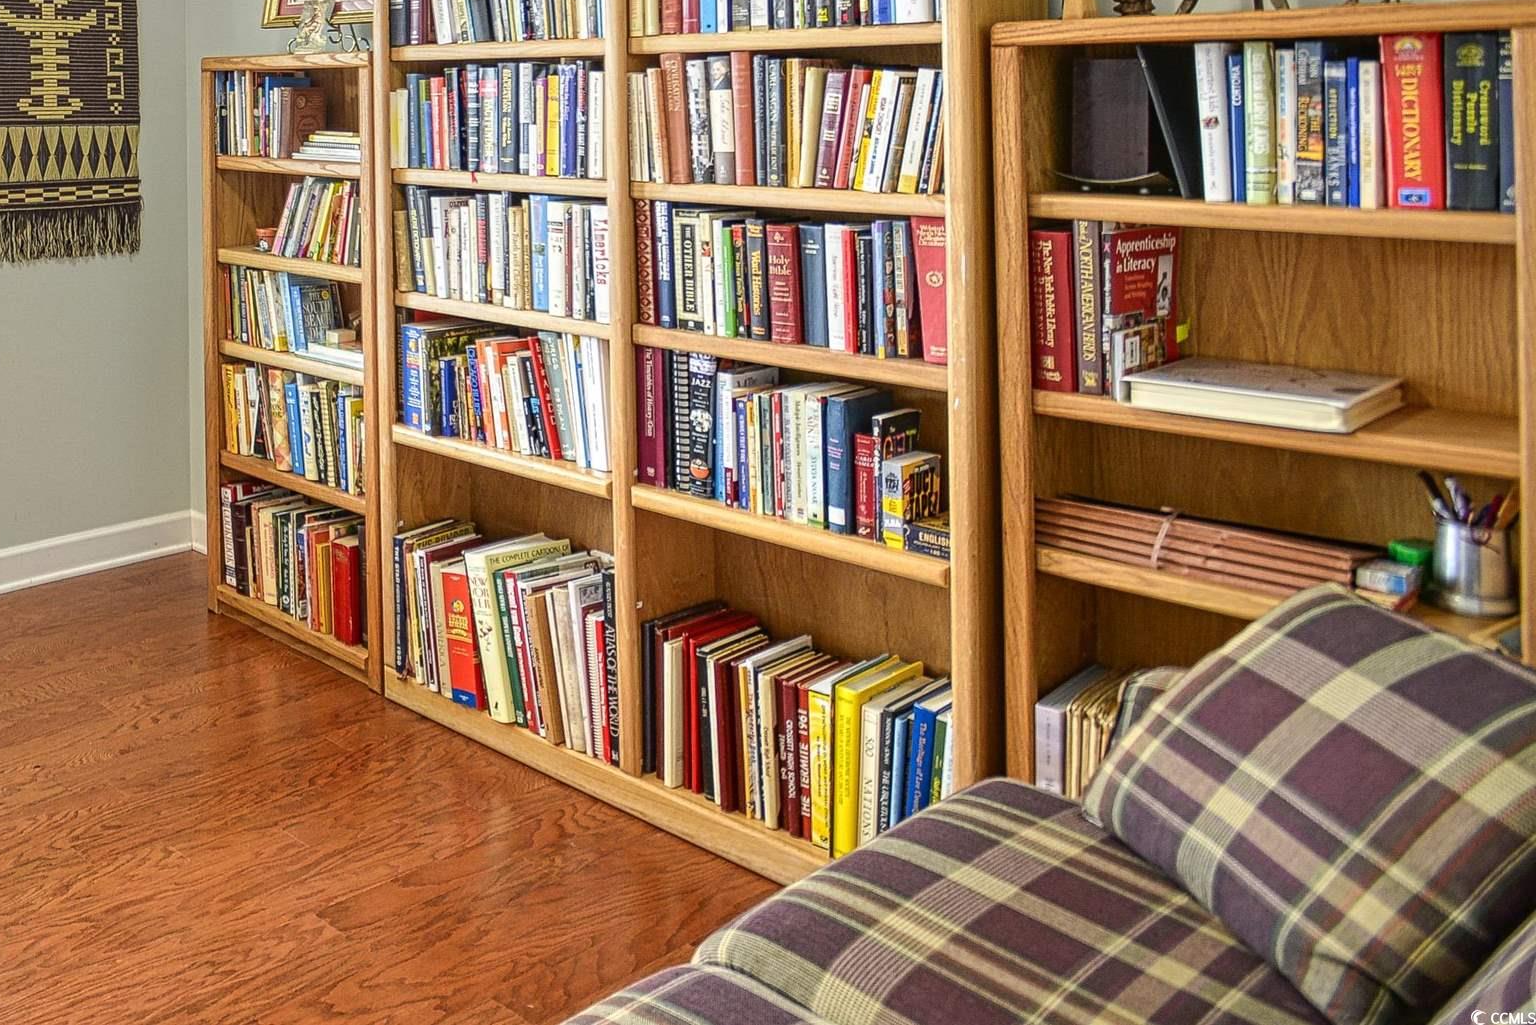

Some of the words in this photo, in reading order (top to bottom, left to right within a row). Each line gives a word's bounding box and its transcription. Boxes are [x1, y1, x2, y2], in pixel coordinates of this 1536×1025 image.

[669, 60, 681, 112] CIVILISATION
[769, 91, 778, 122] SAGAN
[1208, 95, 1219, 113] kids
[1328, 87, 1338, 139] AFFLICTION
[1450, 79, 1464, 146] Dictionary
[1466, 92, 1478, 134] Puzzle
[1479, 79, 1492, 146] Crossword
[1297, 96, 1310, 152] RECKONING
[1309, 115, 1321, 133] THE
[1401, 77, 1422, 182] DICTIONARY
[1327, 146, 1340, 187] BANKS
[593, 218, 608, 286] Limericks
[683, 239, 695, 277] OTHER
[1041, 239, 1053, 256] The
[1116, 232, 1176, 258] Apprenticeship
[751, 250, 761, 274] Word
[768, 255, 791, 265] Holy
[1043, 256, 1053, 275] New
[1079, 240, 1094, 280] NORTH
[1116, 261, 1123, 273] in
[1123, 256, 1156, 273] Literacy
[684, 279, 695, 312] BIBLE
[735, 277, 743, 296] Family
[752, 275, 763, 315] Histories
[1044, 275, 1054, 294] York
[303, 302, 331, 313] SOUTH
[1045, 294, 1055, 319] Public
[1081, 279, 1095, 332] AMERICAN
[303, 314, 332, 327] BEACH
[1045, 318, 1056, 348] Library
[547, 337, 559, 370] LYRICS
[645, 348, 654, 360] The
[1082, 333, 1097, 362] BIRDS
[467, 347, 479, 386] CHICAGO
[645, 360, 655, 391] Timetables
[646, 390, 655, 398] of
[691, 378, 712, 387] JAZZ
[469, 385, 482, 416] BLUES
[489, 557, 500, 566] THE
[502, 552, 530, 563] COMPLETE
[532, 547, 558, 558] CARTOONS
[505, 577, 519, 609] Vincent
[437, 621, 446, 667] AMERICA
[510, 625, 523, 647] Gogh
[605, 624, 618, 653] ATLAS
[606, 653, 618, 672] OF
[607, 673, 618, 695] THE
[607, 695, 620, 737] WORLD
[798, 709, 809, 735] 1961
[920, 722, 929, 735] The
[785, 719, 795, 752] CROSSETT
[865, 736, 876, 758] 500
[763, 747, 771, 761] High
[786, 751, 795, 771] HIGH
[799, 742, 810, 789] TERMITE
[787, 771, 797, 799] SCHOOL
[916, 768, 926, 777] of
[800, 795, 811, 817] THE
[862, 776, 874, 838] NATIONS
